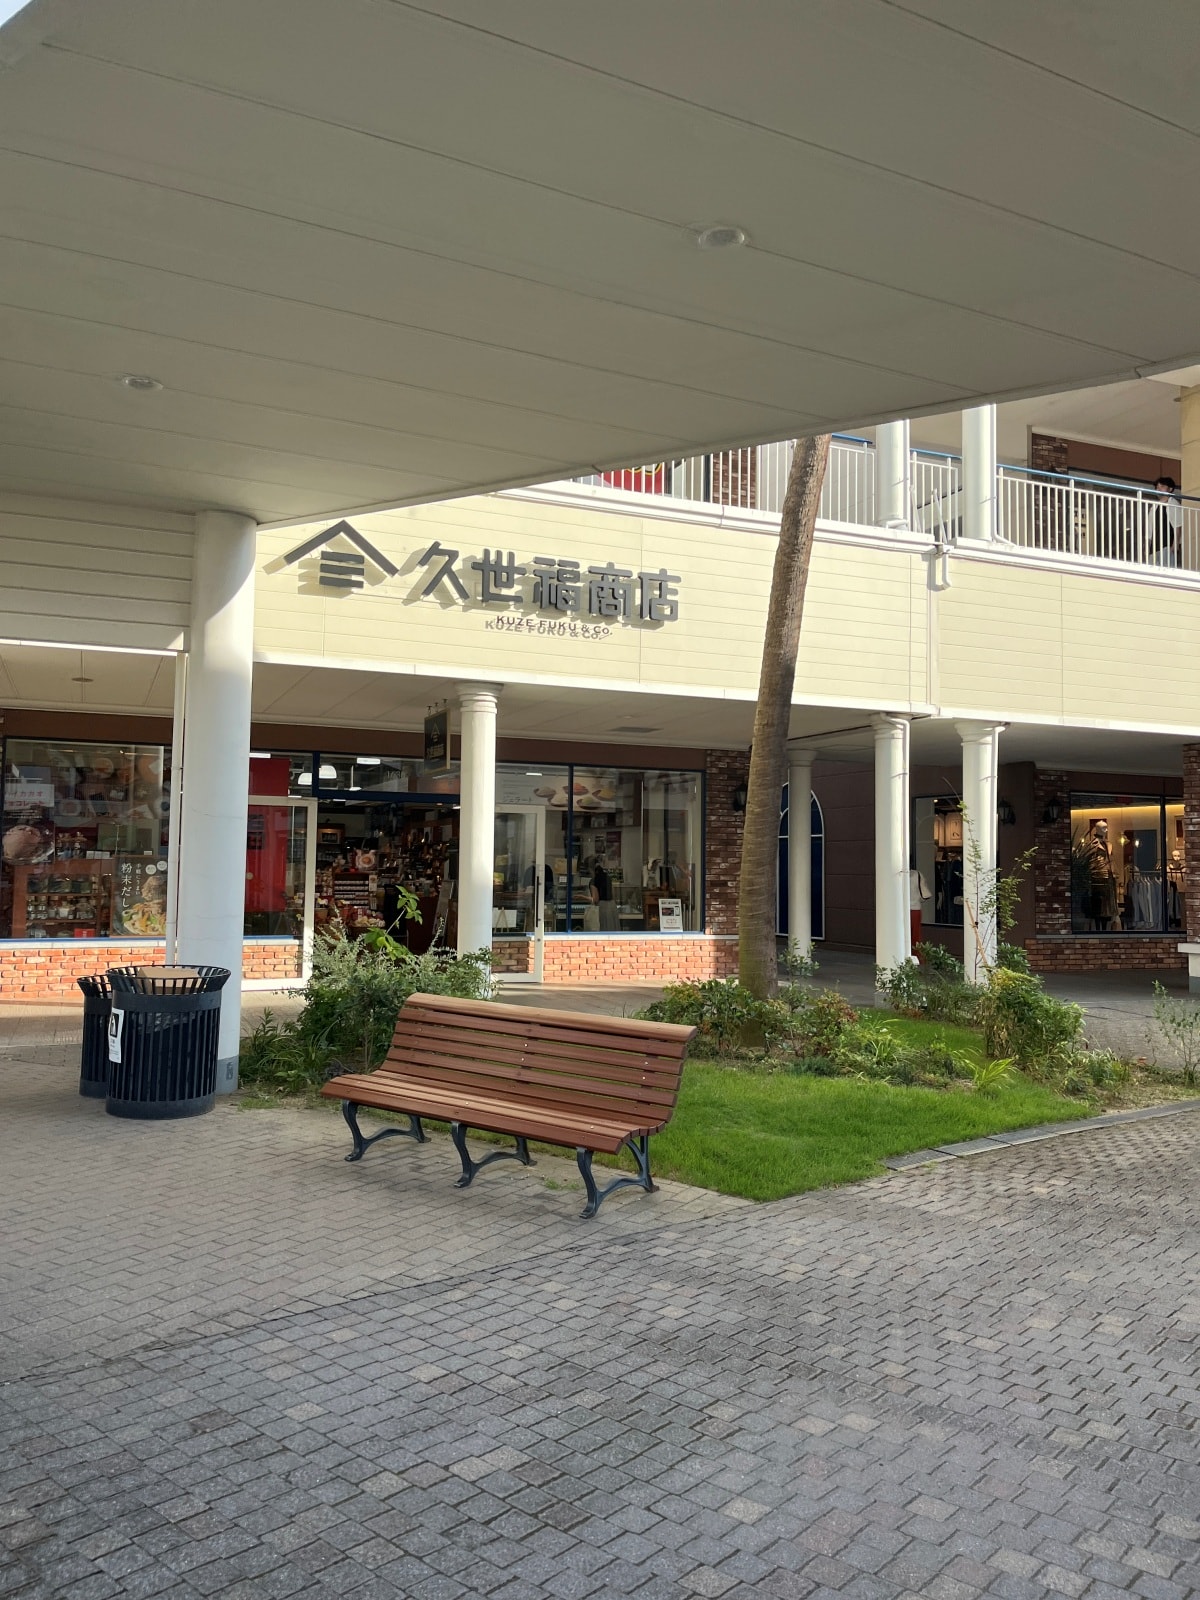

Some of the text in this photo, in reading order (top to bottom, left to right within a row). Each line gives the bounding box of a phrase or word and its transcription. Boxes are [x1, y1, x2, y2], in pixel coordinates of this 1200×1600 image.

[417, 541, 682, 622] 久世福商店
[496, 615, 535, 628] KUZE
[540, 619, 577, 633] FUKU
[581, 624, 590, 634] &
[121, 862, 133, 908] 粉末だし
